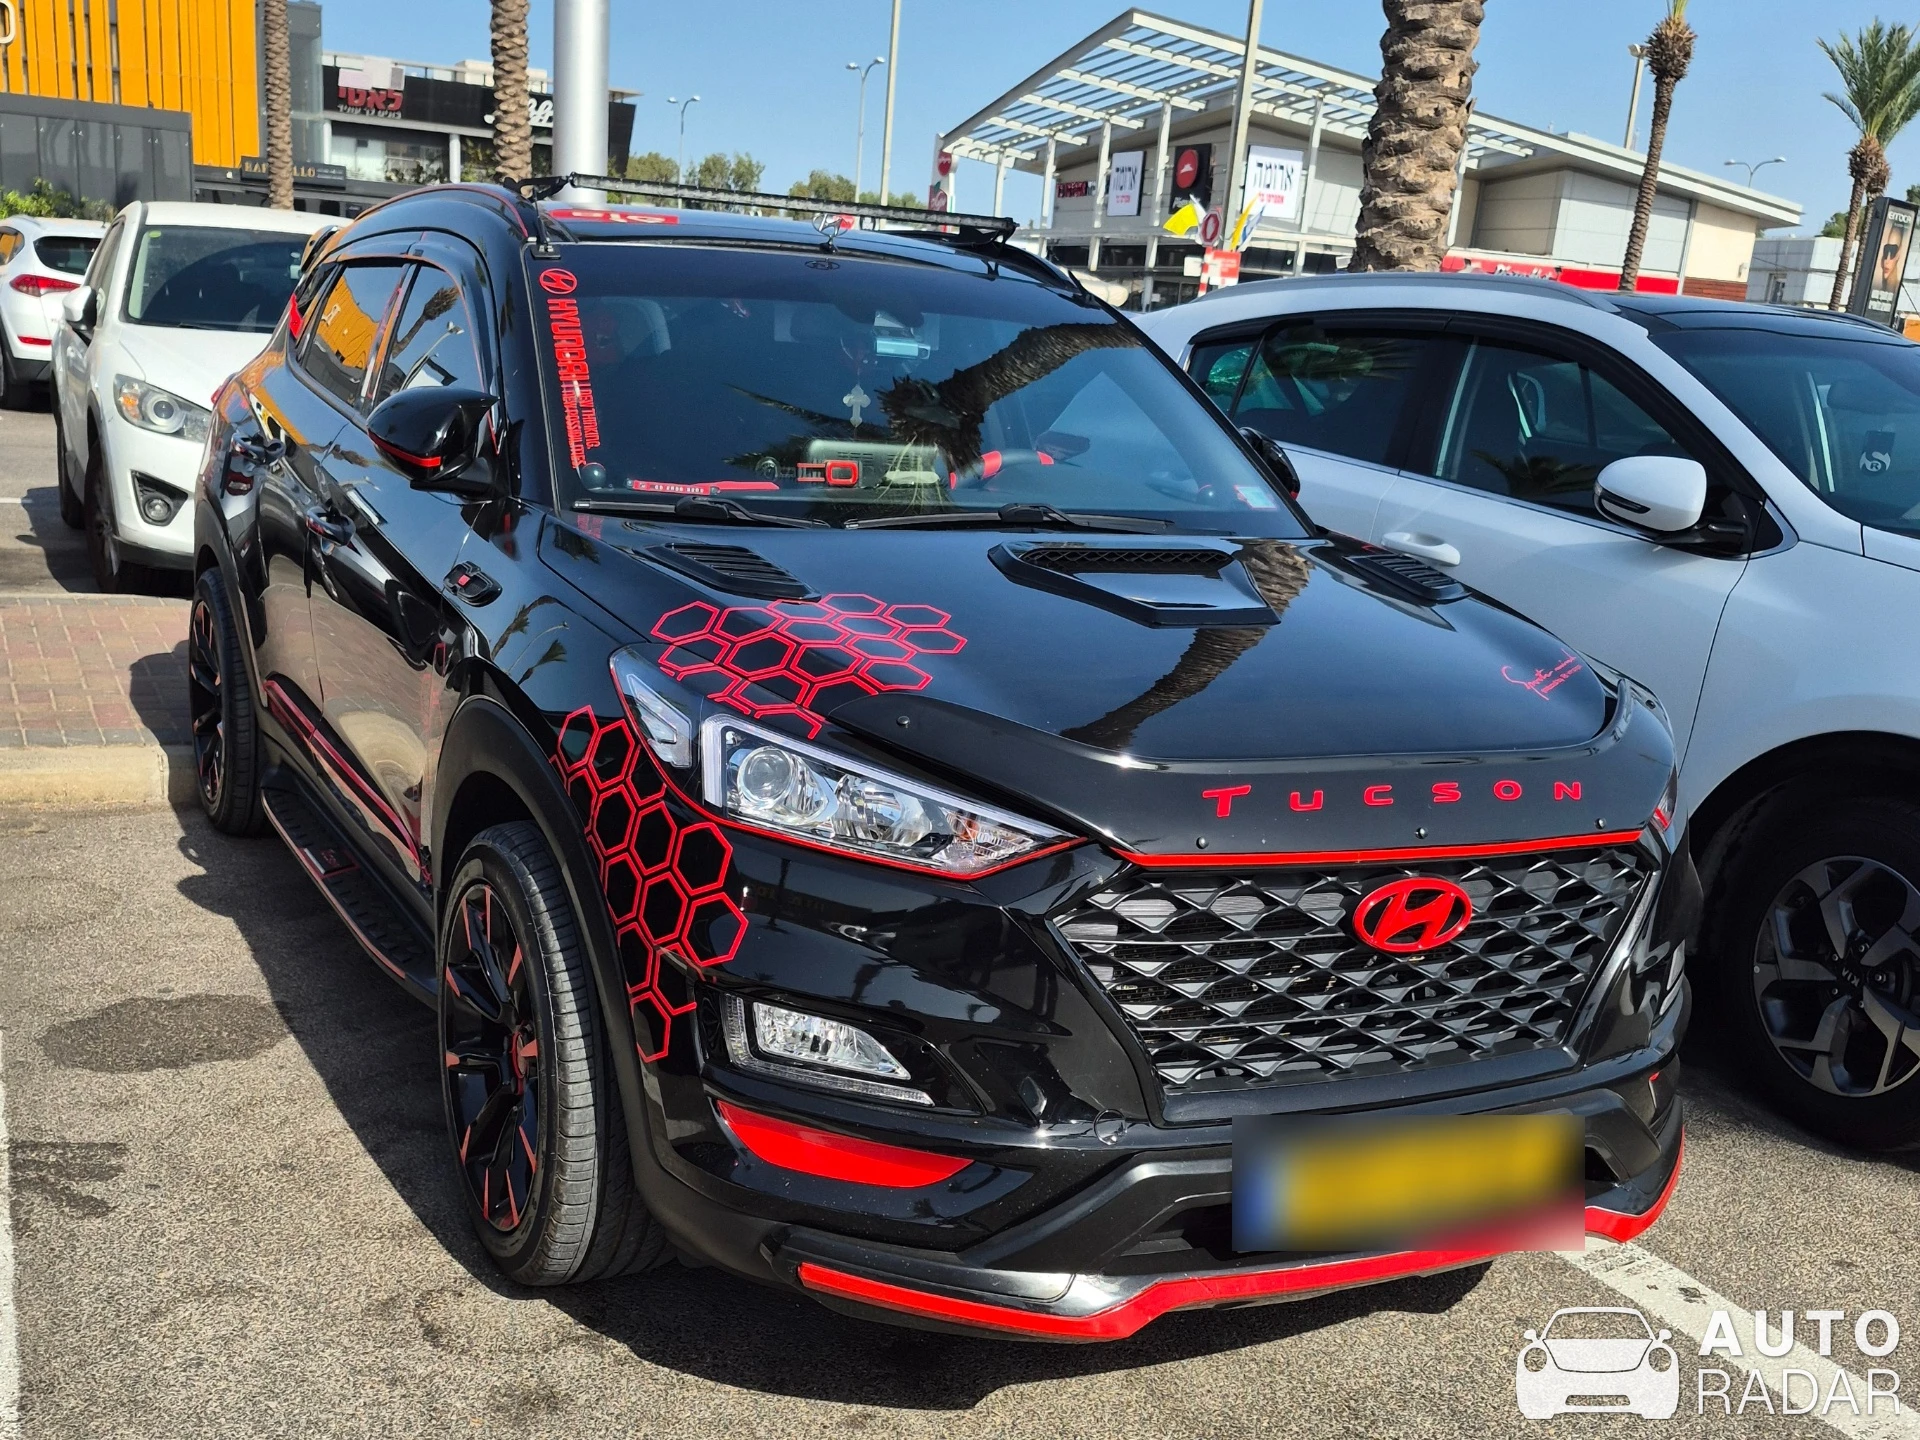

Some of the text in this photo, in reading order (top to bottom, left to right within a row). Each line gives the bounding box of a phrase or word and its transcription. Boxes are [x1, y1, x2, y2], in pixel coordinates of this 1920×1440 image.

[1253, 162, 1294, 191] ארומה
[547, 298, 590, 381] HYUNDAI
[1202, 779, 1582, 818] TUCSON
[1841, 968, 1860, 988] KIA
